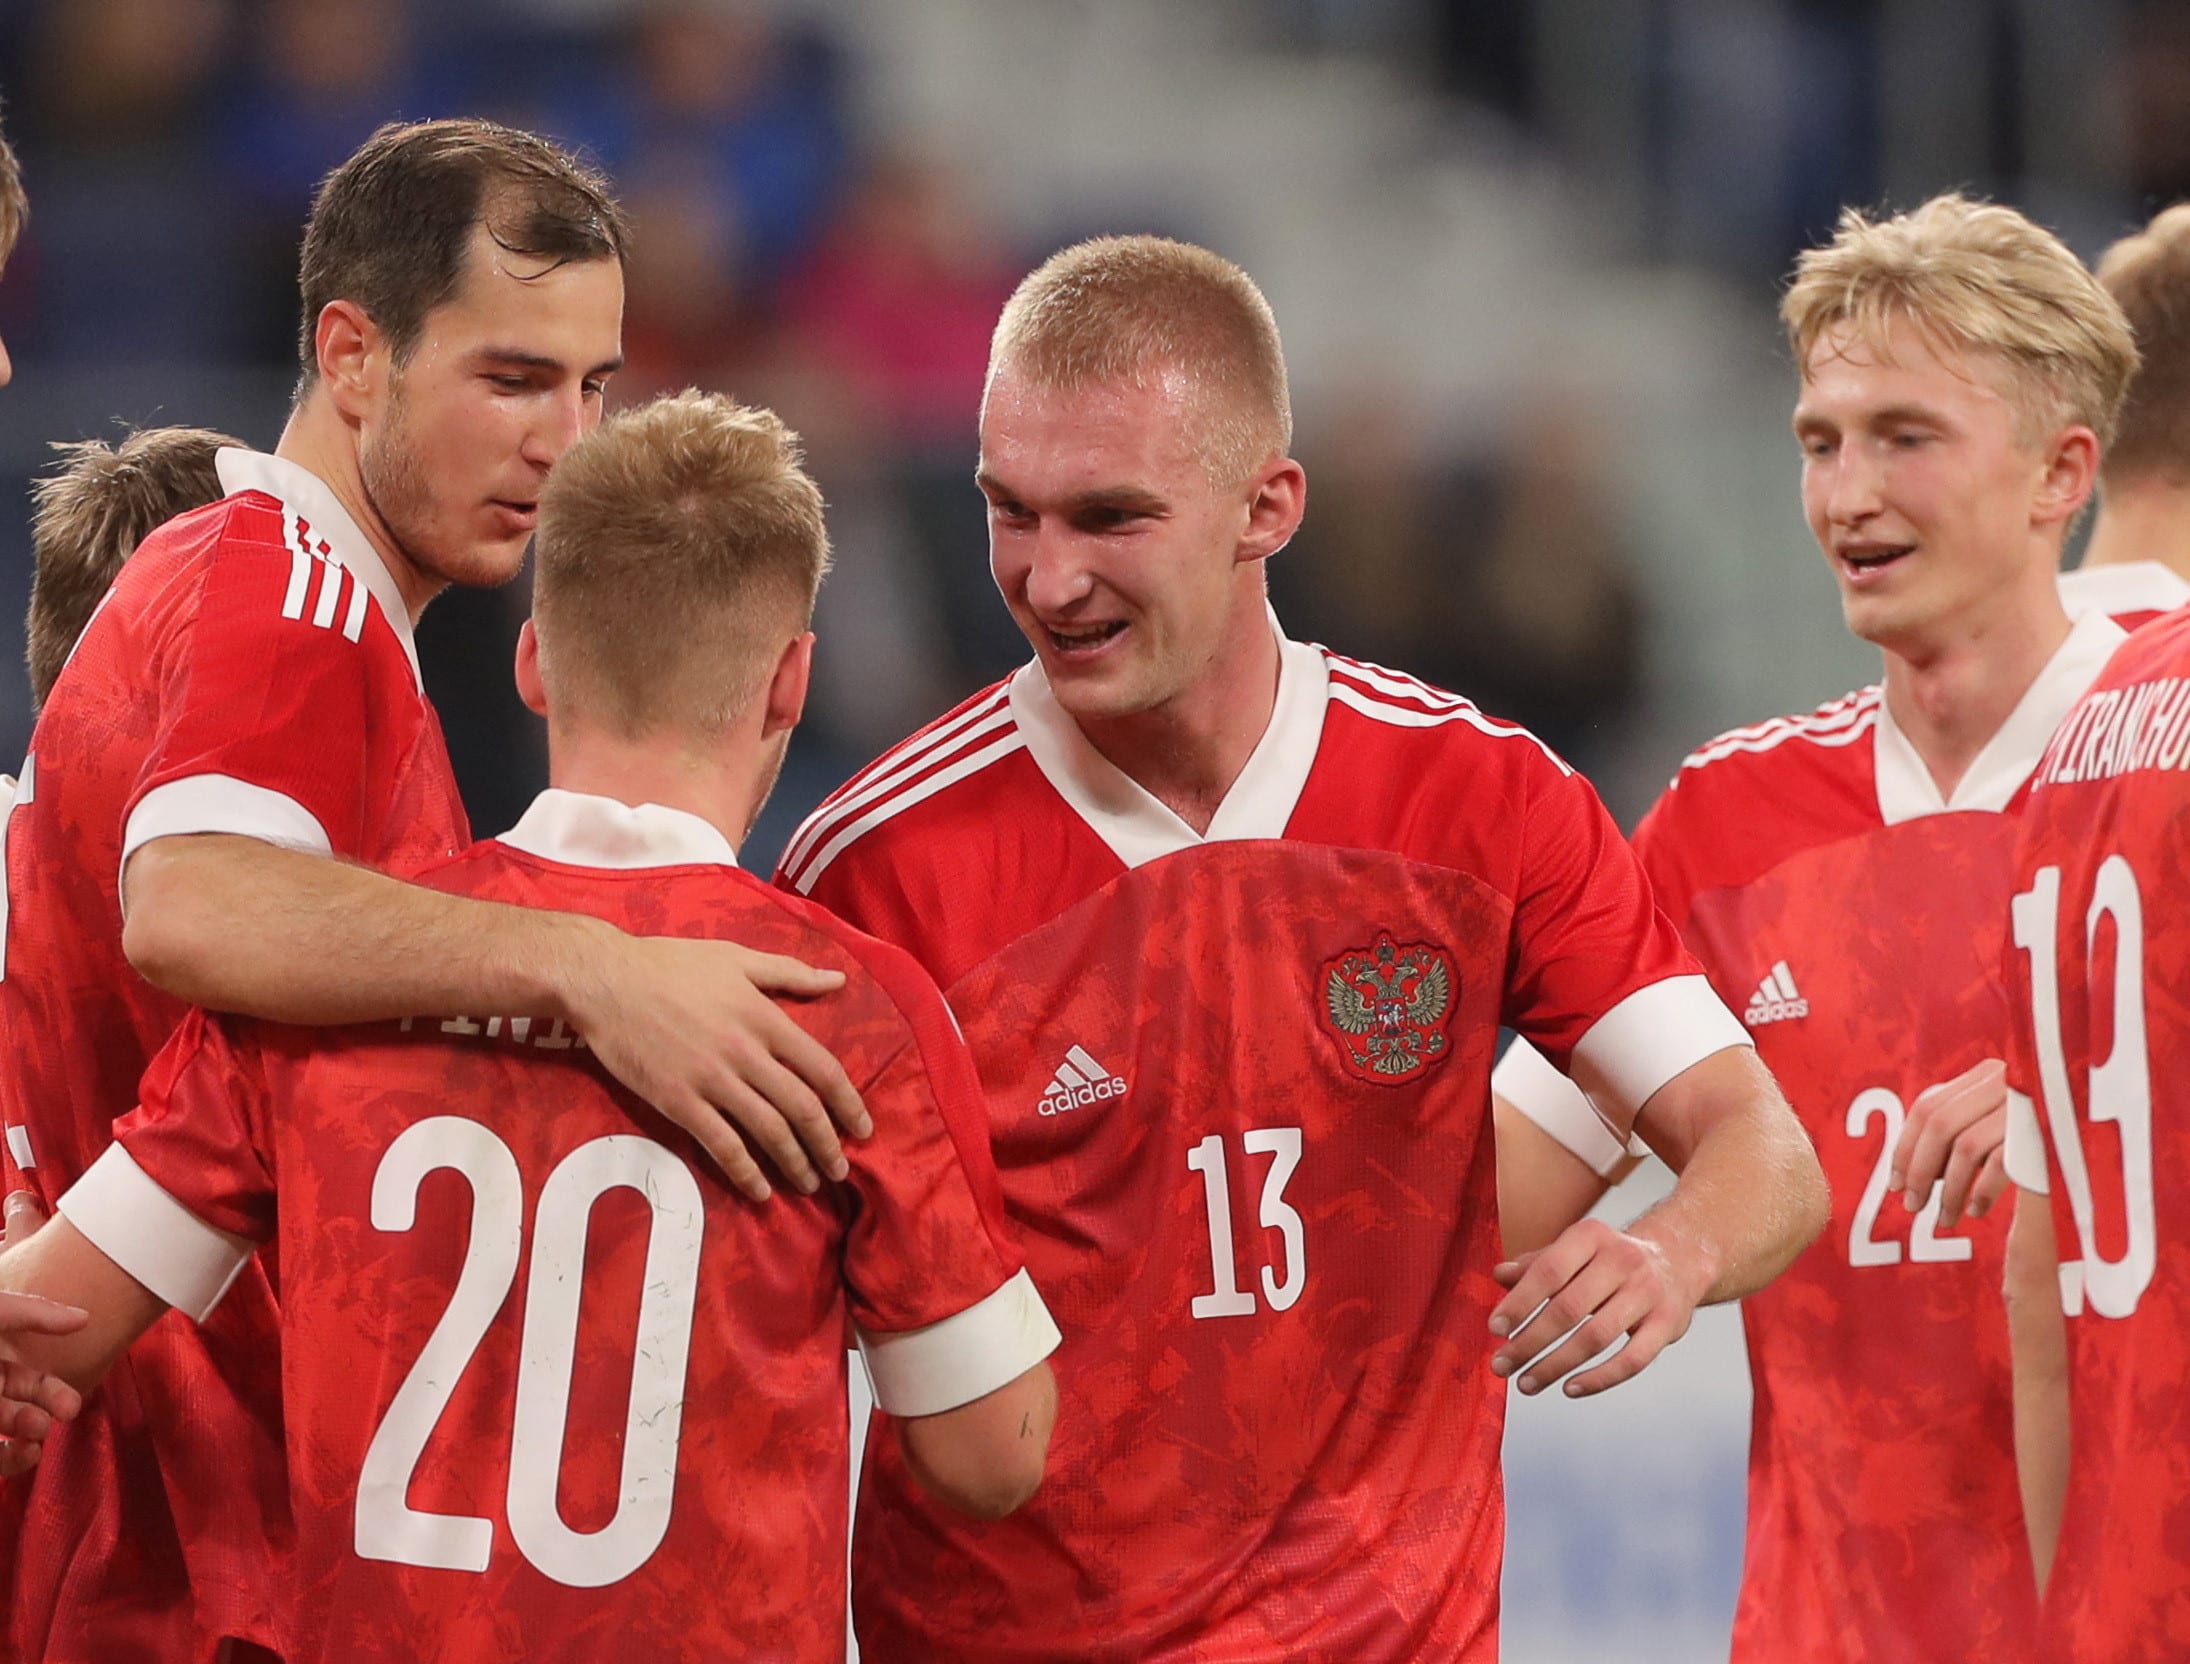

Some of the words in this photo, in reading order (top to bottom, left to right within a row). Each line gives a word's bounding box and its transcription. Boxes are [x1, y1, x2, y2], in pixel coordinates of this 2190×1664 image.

[1745, 999, 1809, 1025] adidas
[1038, 1076, 1128, 1116] adidas
[1187, 1127, 1306, 1319] 13
[354, 1115, 705, 1588] 20
